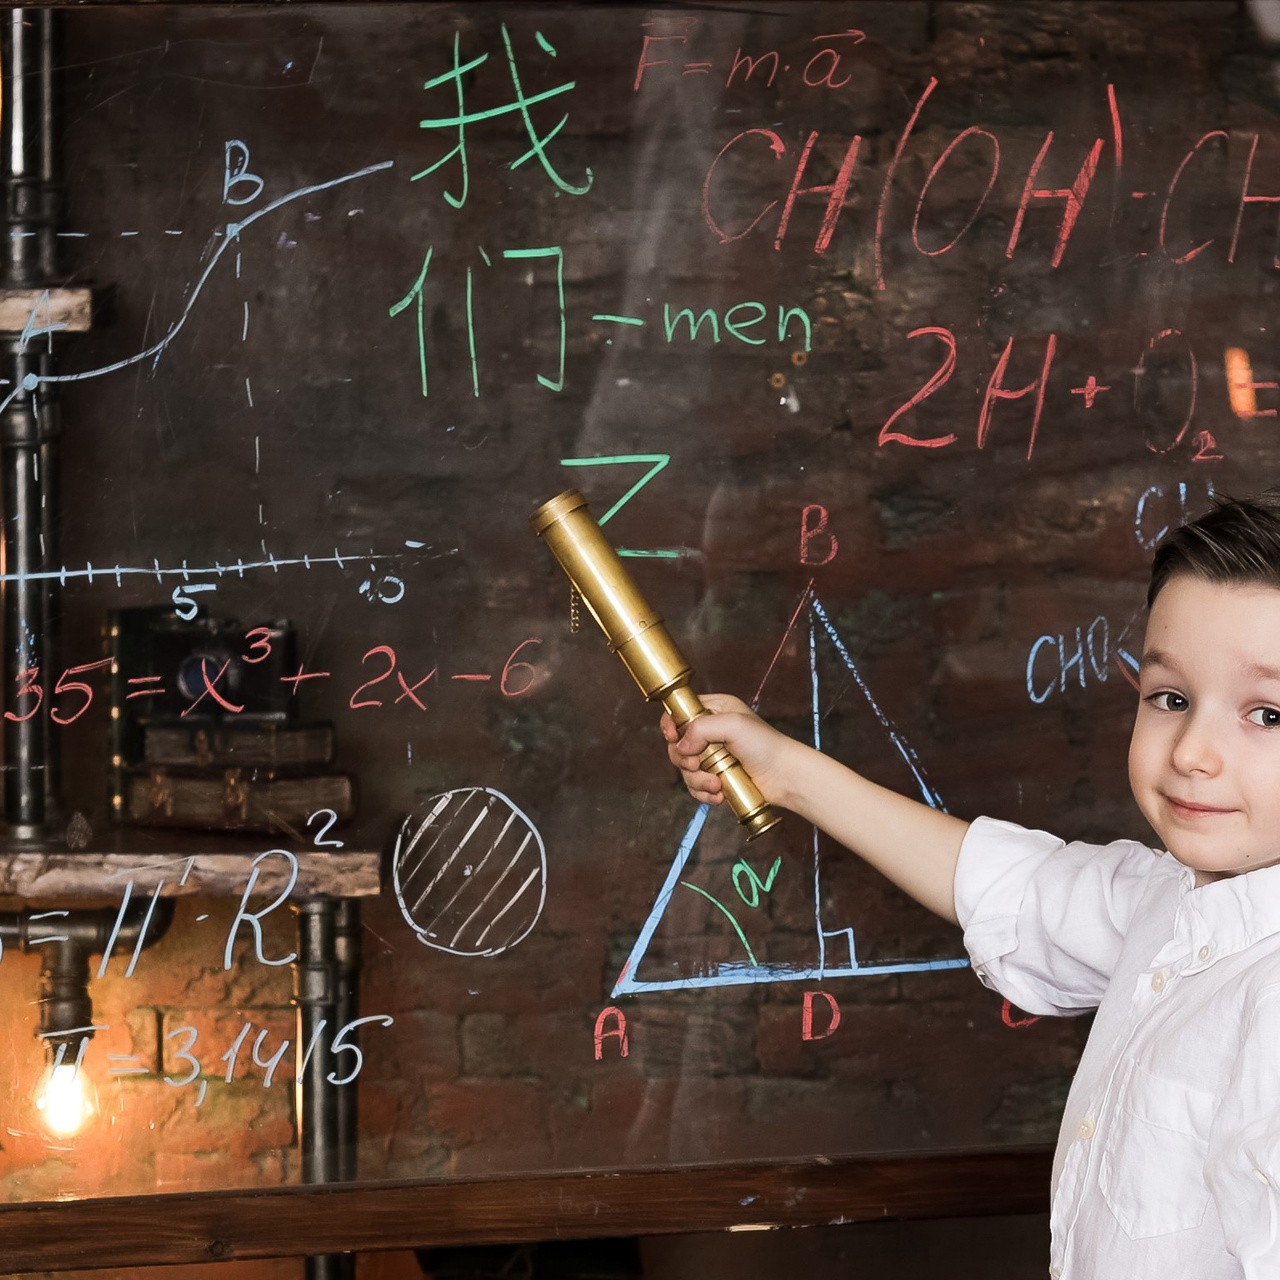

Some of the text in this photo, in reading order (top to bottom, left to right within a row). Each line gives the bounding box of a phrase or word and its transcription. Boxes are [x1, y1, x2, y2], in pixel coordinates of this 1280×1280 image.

[410, 22, 593, 208] 我
[223, 139, 264, 205] B
[19, 289, 69, 356] A
[800, 504, 839, 566] B
[171, 583, 217, 621] 5
[594, 1006, 629, 1060] A
[802, 990, 841, 1041] D
